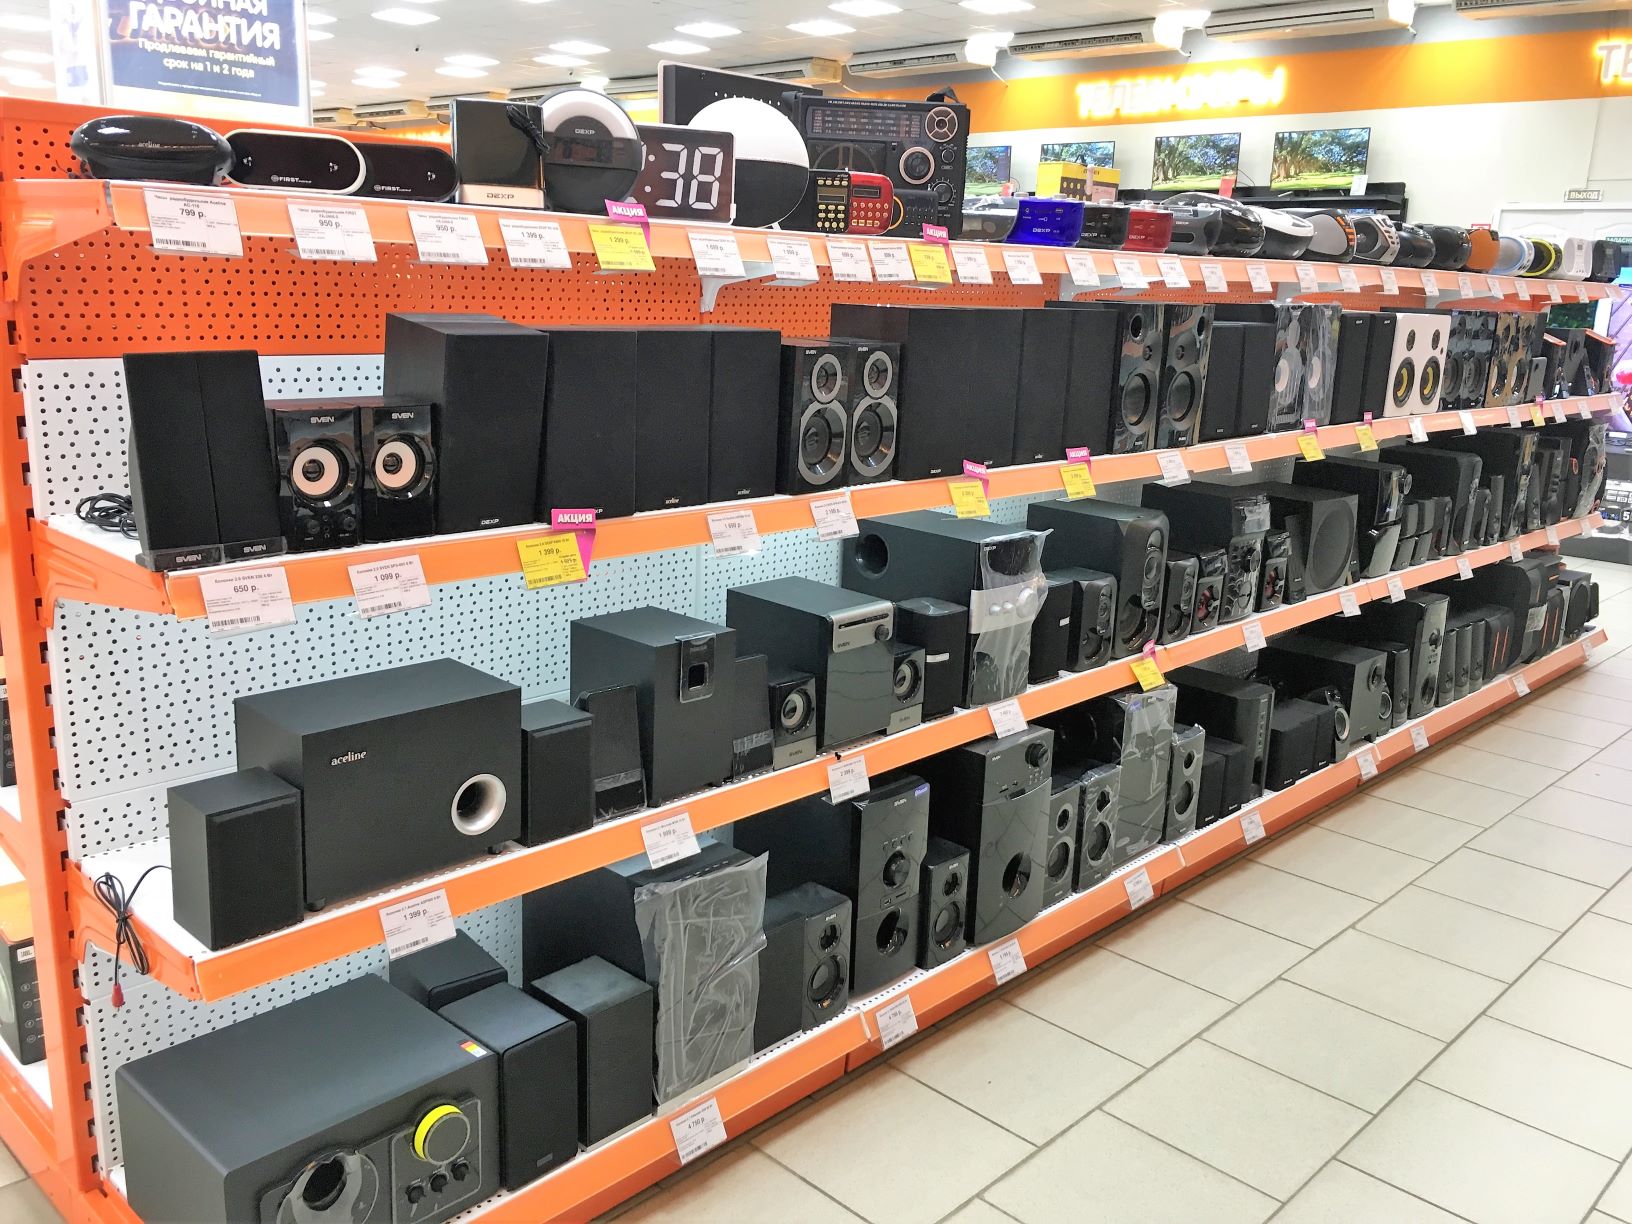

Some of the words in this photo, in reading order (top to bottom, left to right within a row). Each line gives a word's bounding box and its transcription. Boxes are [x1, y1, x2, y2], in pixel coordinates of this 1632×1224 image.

[129, 1, 281, 50] ГАРАНТИЯ
[162, 57, 189, 70] срок
[190, 61, 204, 71] на
[205, 61, 211, 72] 1
[212, 64, 221, 74] и
[222, 63, 230, 75] 2
[231, 66, 255, 79] года
[486, 192, 515, 200] DEXP
[1569, 191, 1600, 200] ВЫХОД
[179, 208, 196, 217] 799
[611, 205, 645, 218] АКЦИЯ
[318, 219, 333, 227] 950
[926, 227, 948, 238] АКЦИЯ
[310, 415, 335, 424] SVEN
[391, 411, 414, 420] SVEN
[557, 513, 594, 526] АКЦИЯ
[243, 544, 267, 553] SVEN
[176, 553, 202, 563] SVEN
[379, 572, 394, 582] 099
[233, 584, 249, 593] 650
[330, 750, 368, 767] aceline
[408, 910, 421, 920] 399
